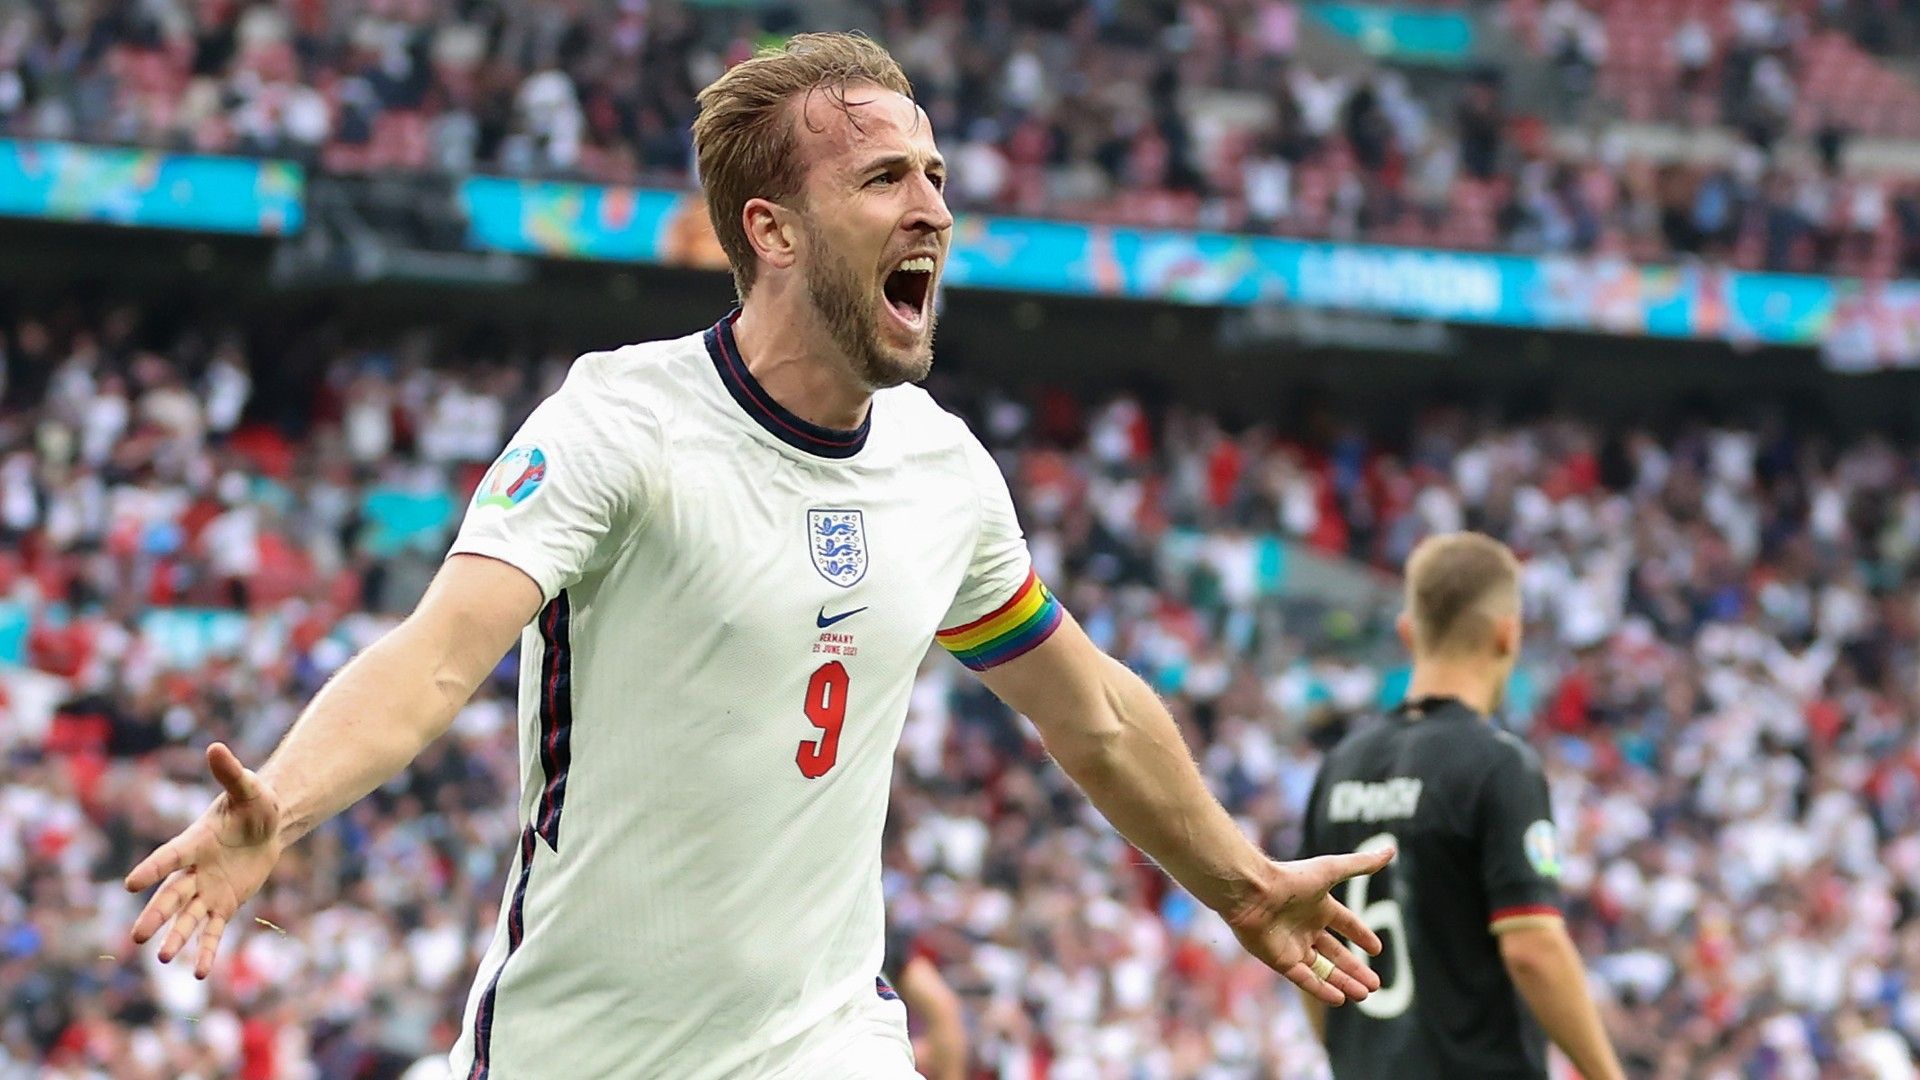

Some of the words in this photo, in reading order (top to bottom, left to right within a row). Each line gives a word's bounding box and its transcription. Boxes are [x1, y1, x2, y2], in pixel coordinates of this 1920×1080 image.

[822, 645, 841, 655] JUNE
[795, 660, 850, 779] 9
[1346, 832, 1415, 1019] 6
